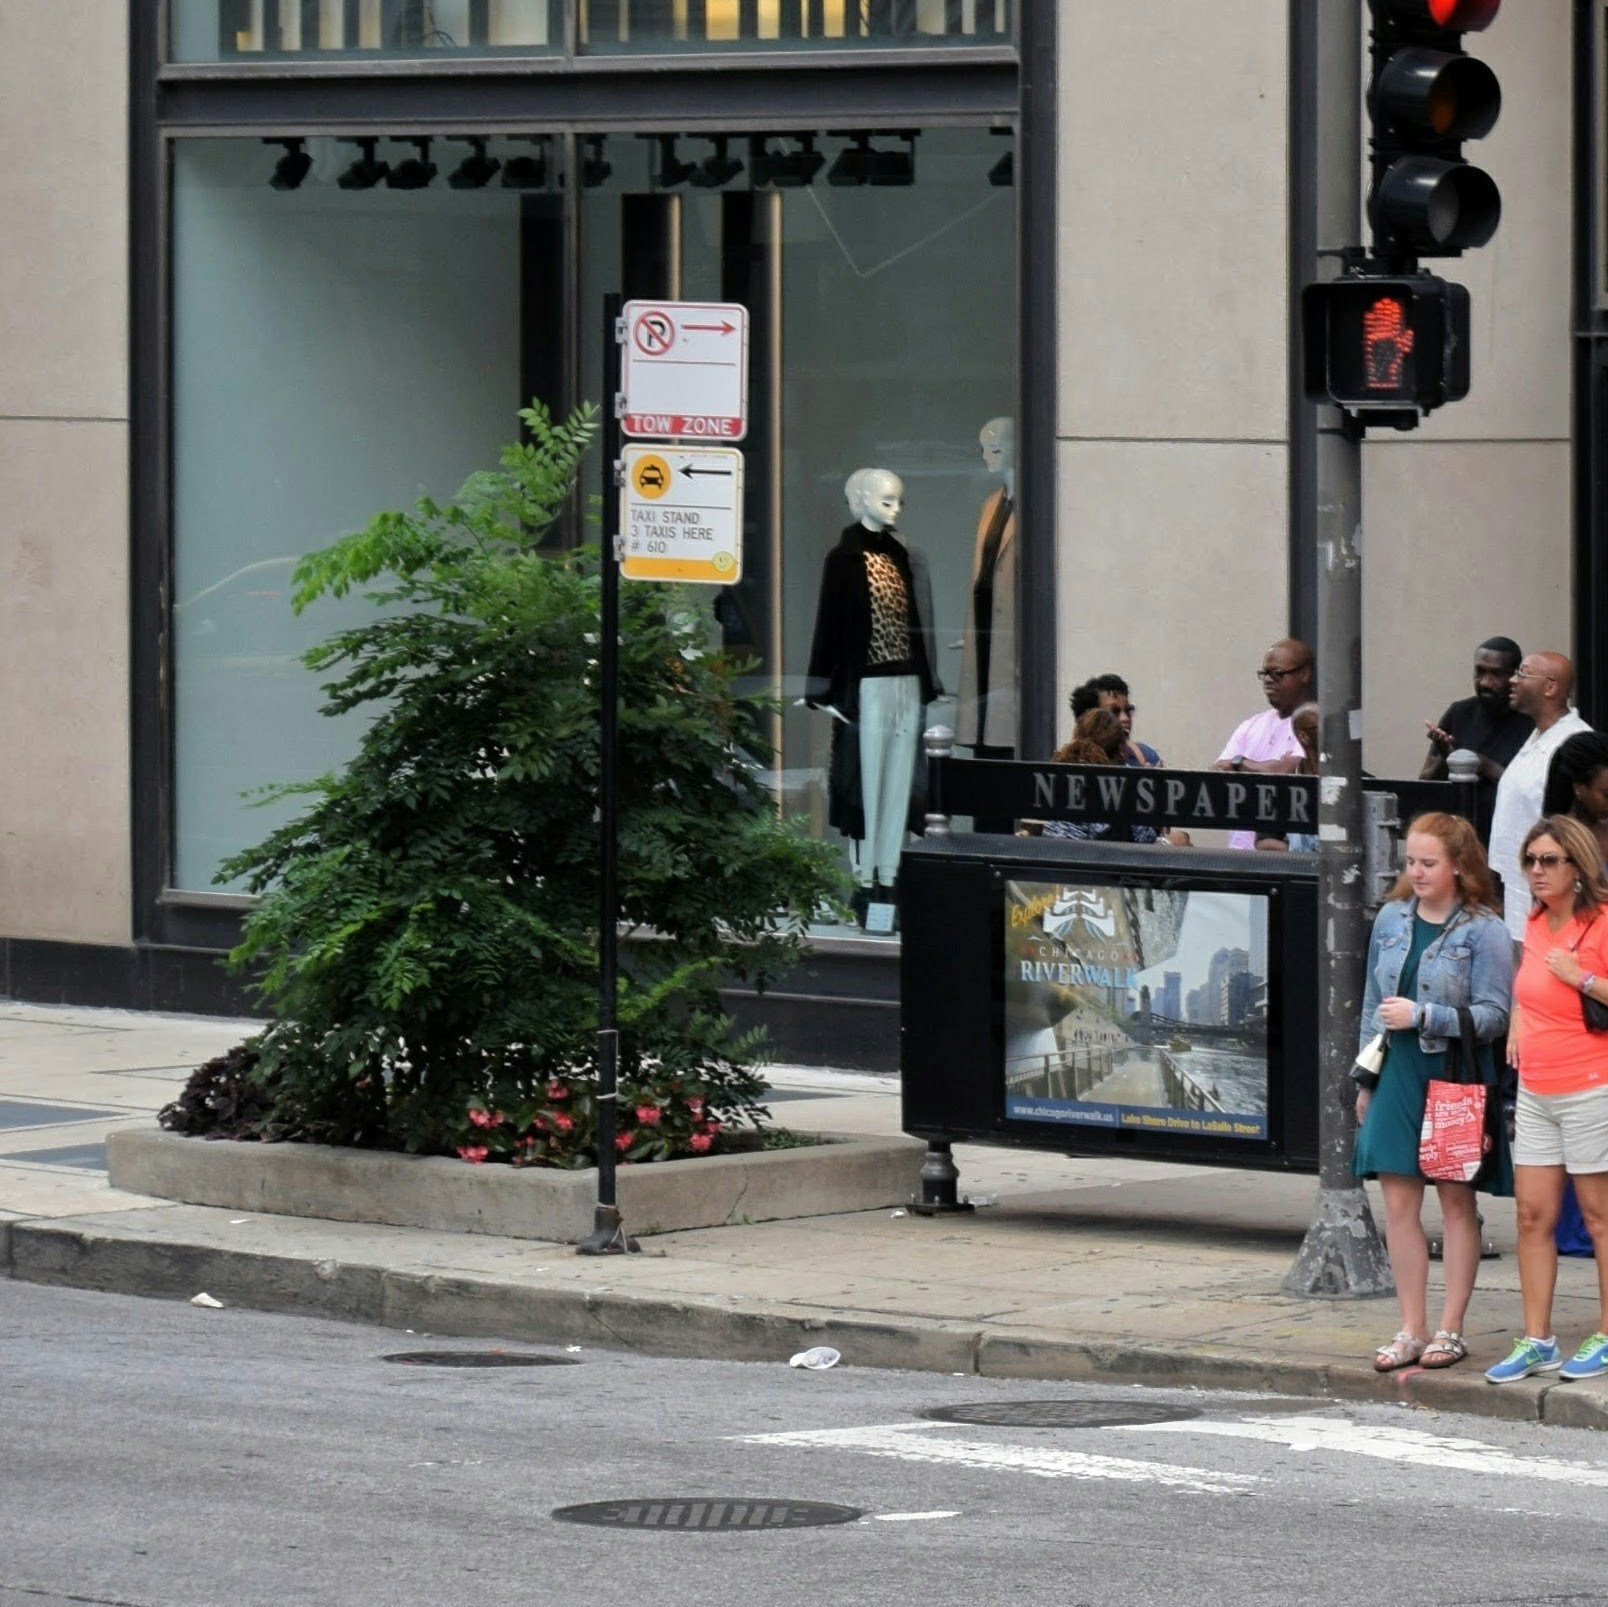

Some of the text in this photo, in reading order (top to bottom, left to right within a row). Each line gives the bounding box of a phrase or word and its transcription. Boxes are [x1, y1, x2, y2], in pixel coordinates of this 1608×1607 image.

[632, 415, 734, 434] TOW ZONE
[631, 509, 700, 524] TAXI STAND
[631, 525, 713, 540] 3 TAXIS HERE
[647, 541, 666, 554] 610
[1033, 772, 1310, 823] NEWSPAPER
[1039, 946, 1119, 961] CHICAGO
[1021, 959, 1139, 990] RIVERWALK
[1121, 1113, 1140, 1124] Lake
[1142, 1115, 1166, 1126] Shore
[1167, 1116, 1189, 1128] Drive
[1191, 1119, 1200, 1129] to
[1233, 1123, 1260, 1134] Street
